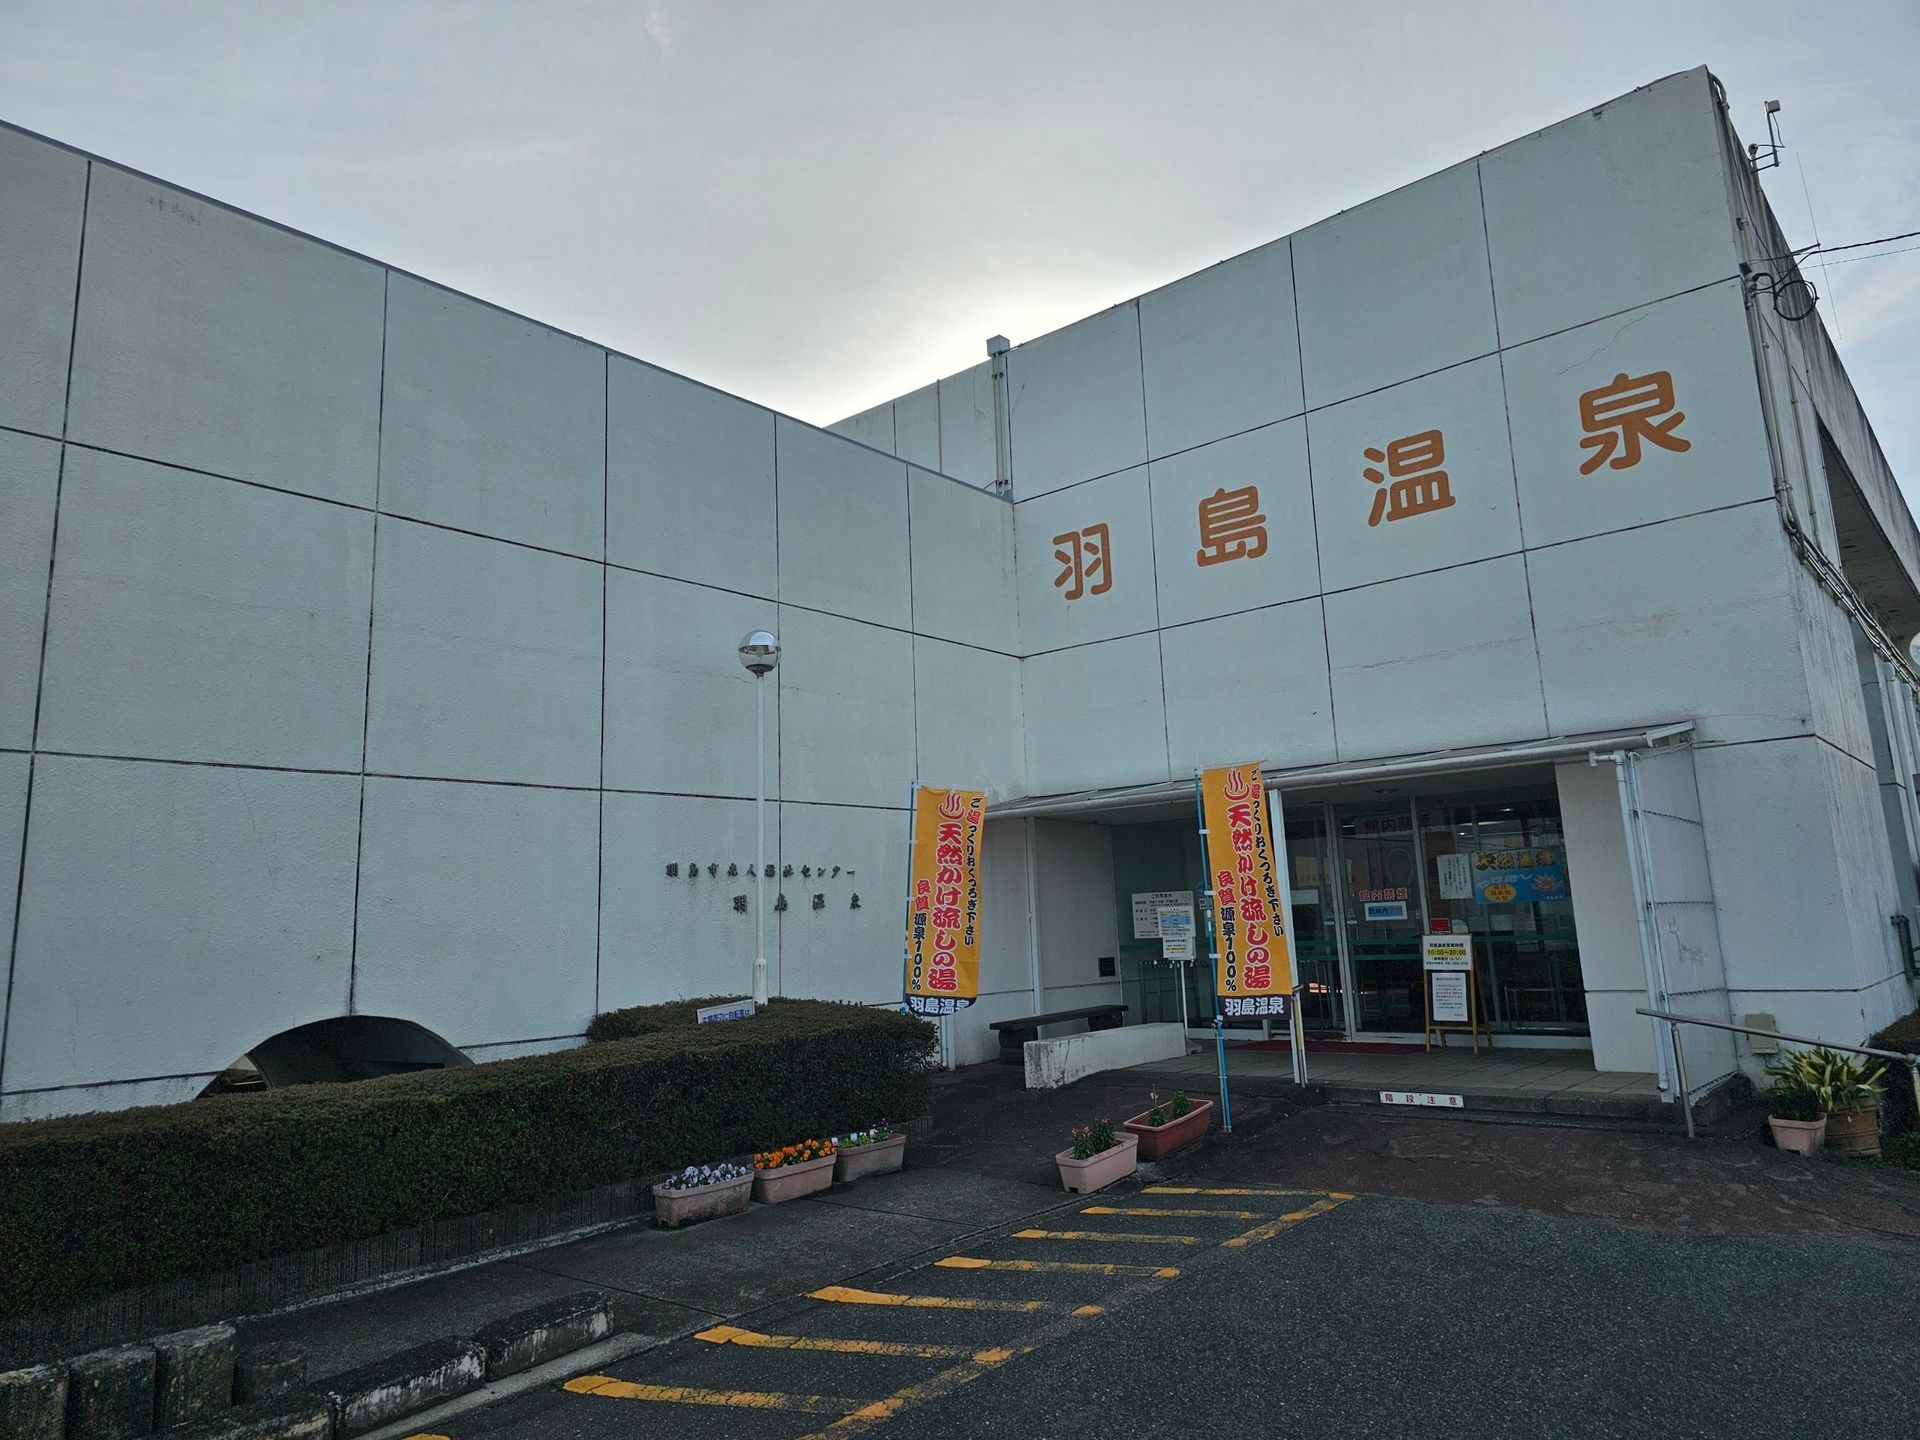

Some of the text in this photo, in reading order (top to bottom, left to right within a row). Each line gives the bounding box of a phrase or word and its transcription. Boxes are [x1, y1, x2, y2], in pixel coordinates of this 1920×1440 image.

[1053, 371, 1691, 600] 羽島温泉
[666, 862, 855, 879] 羽島市老人福祉センター
[733, 893, 862, 913] 羽島温泉
[928, 822, 963, 991] 天然かけ流しの湯
[1226, 803, 1271, 990] 天然かけ流しの湯
[1224, 996, 1284, 1016] 羽島温泉
[1385, 1093, 1458, 1106] 階段注意
